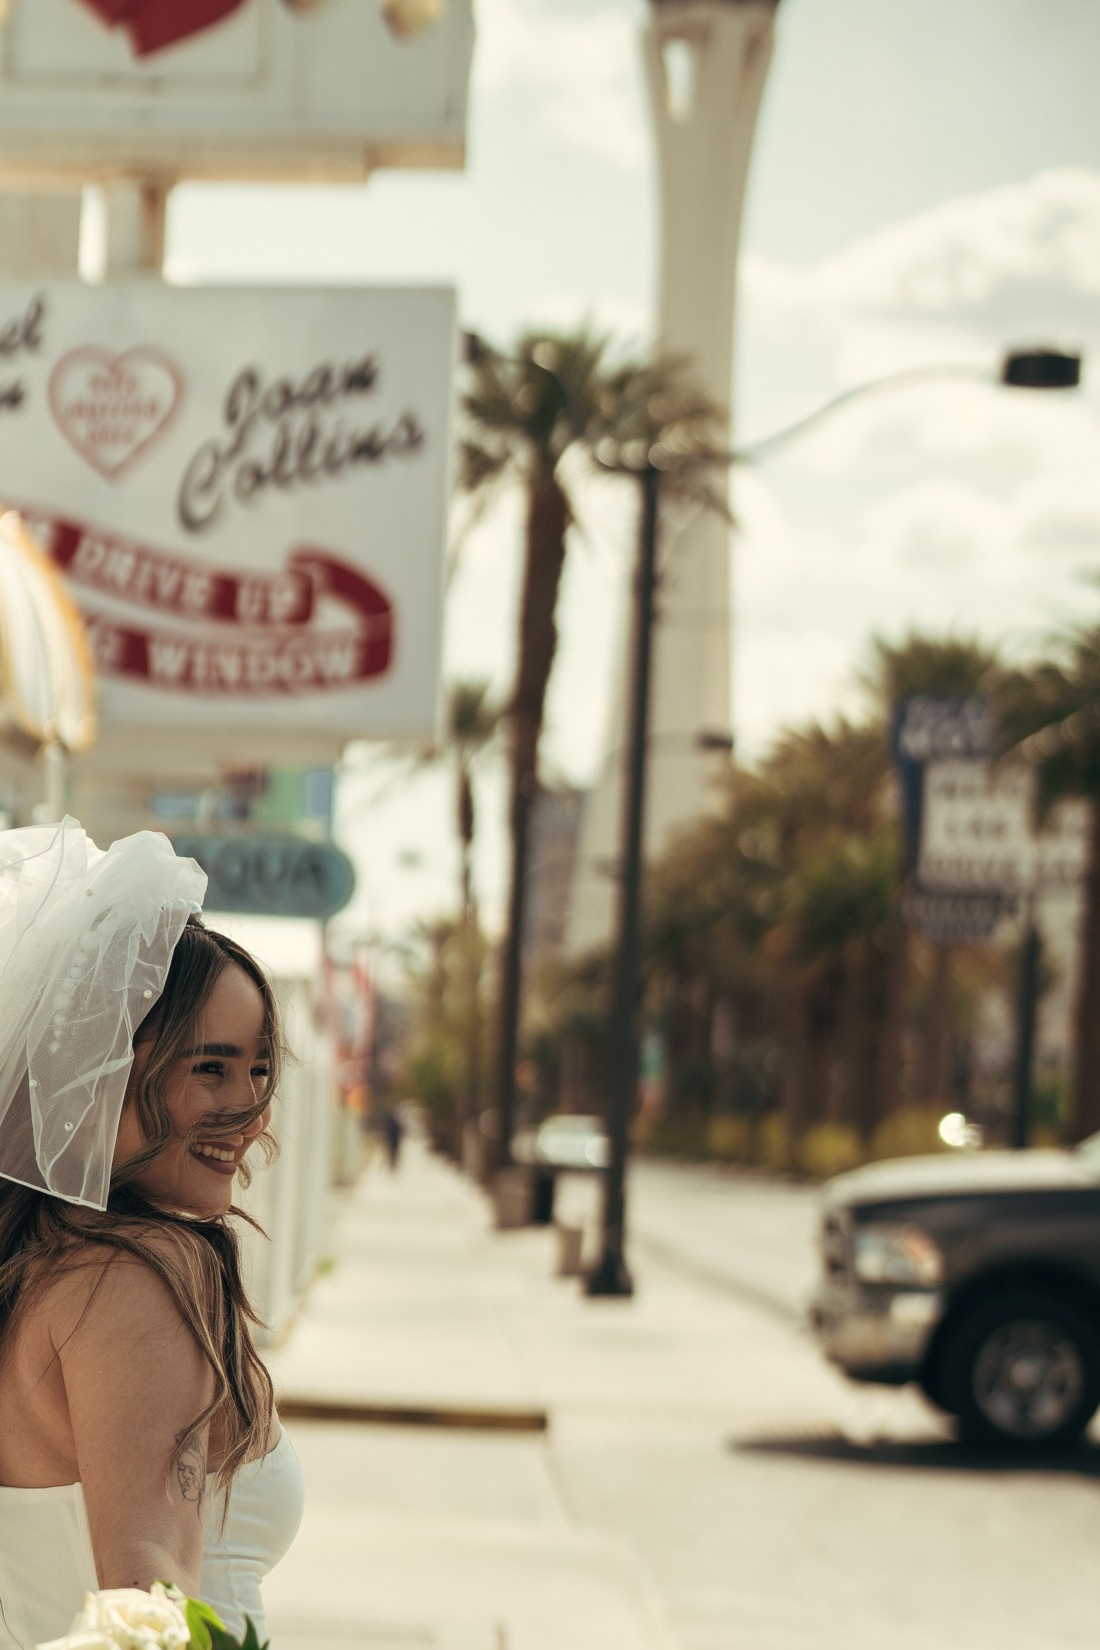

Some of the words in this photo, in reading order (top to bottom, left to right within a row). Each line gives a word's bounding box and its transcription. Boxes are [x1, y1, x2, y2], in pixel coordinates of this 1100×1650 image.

[222, 353, 377, 464] Joan
[176, 404, 425, 535] Collins
[73, 537, 212, 607] DRIVE
[235, 577, 296, 622] UP
[147, 640, 356, 685] WINDOW
